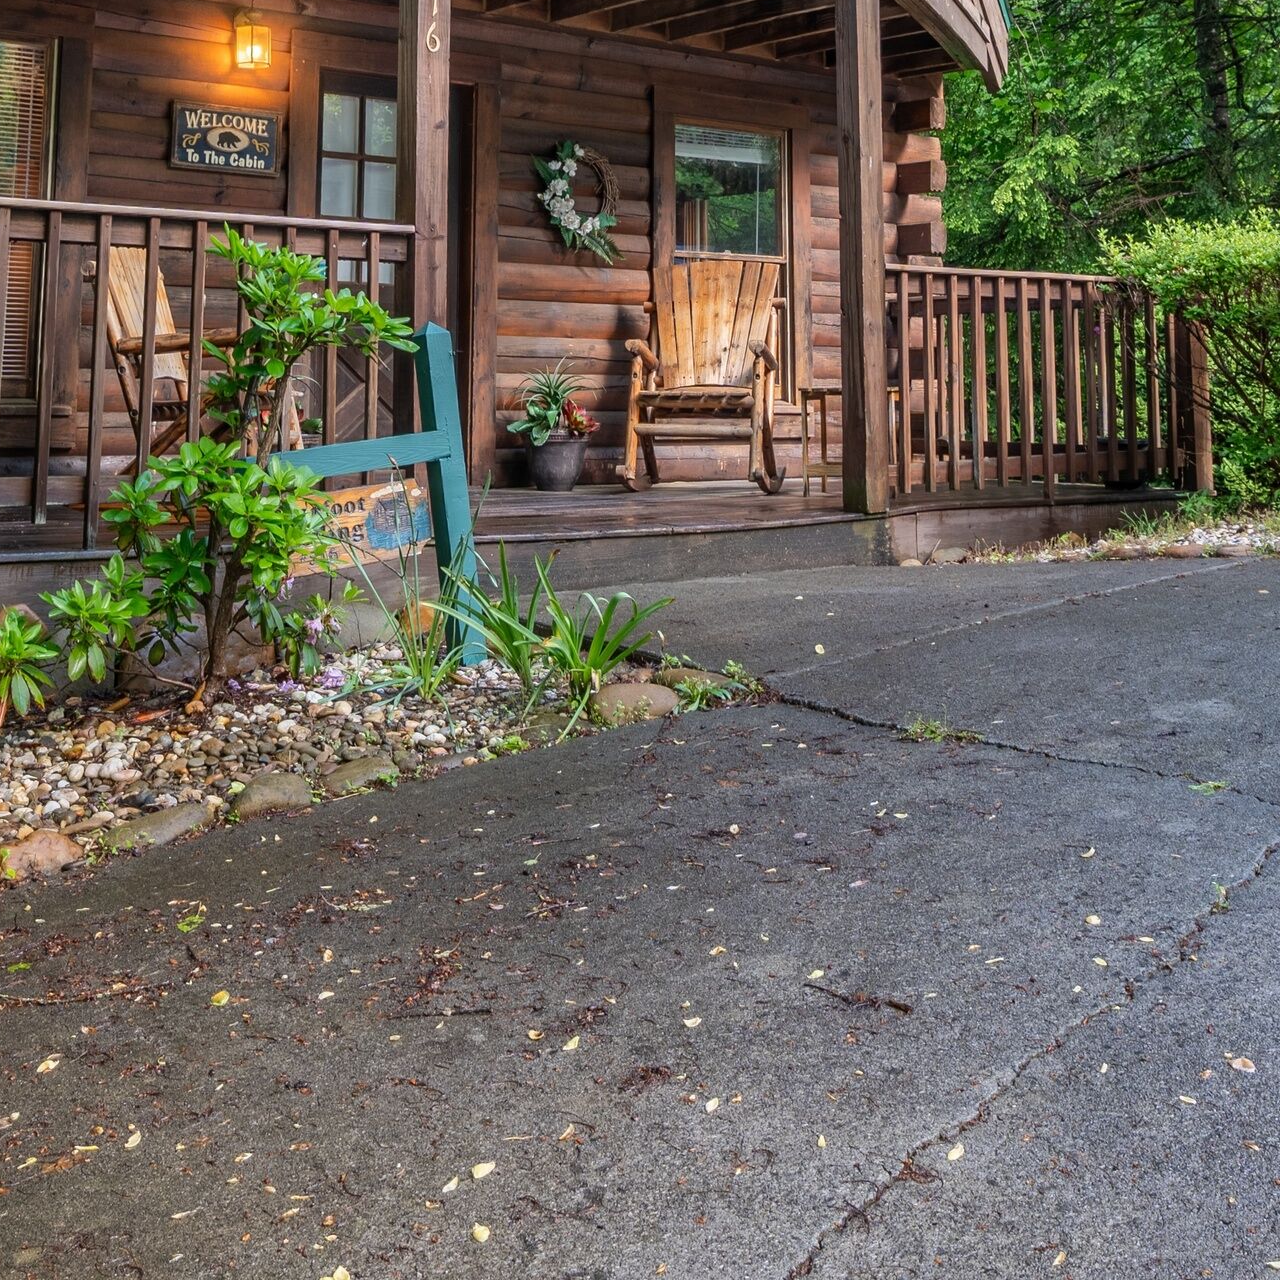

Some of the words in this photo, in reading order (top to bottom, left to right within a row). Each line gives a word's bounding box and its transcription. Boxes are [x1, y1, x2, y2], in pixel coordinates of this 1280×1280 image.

[185, 109, 269, 137] WELCOME
[186, 148, 199, 163] To
[204, 150, 226, 165] The
[229, 153, 265, 169] Cabin
